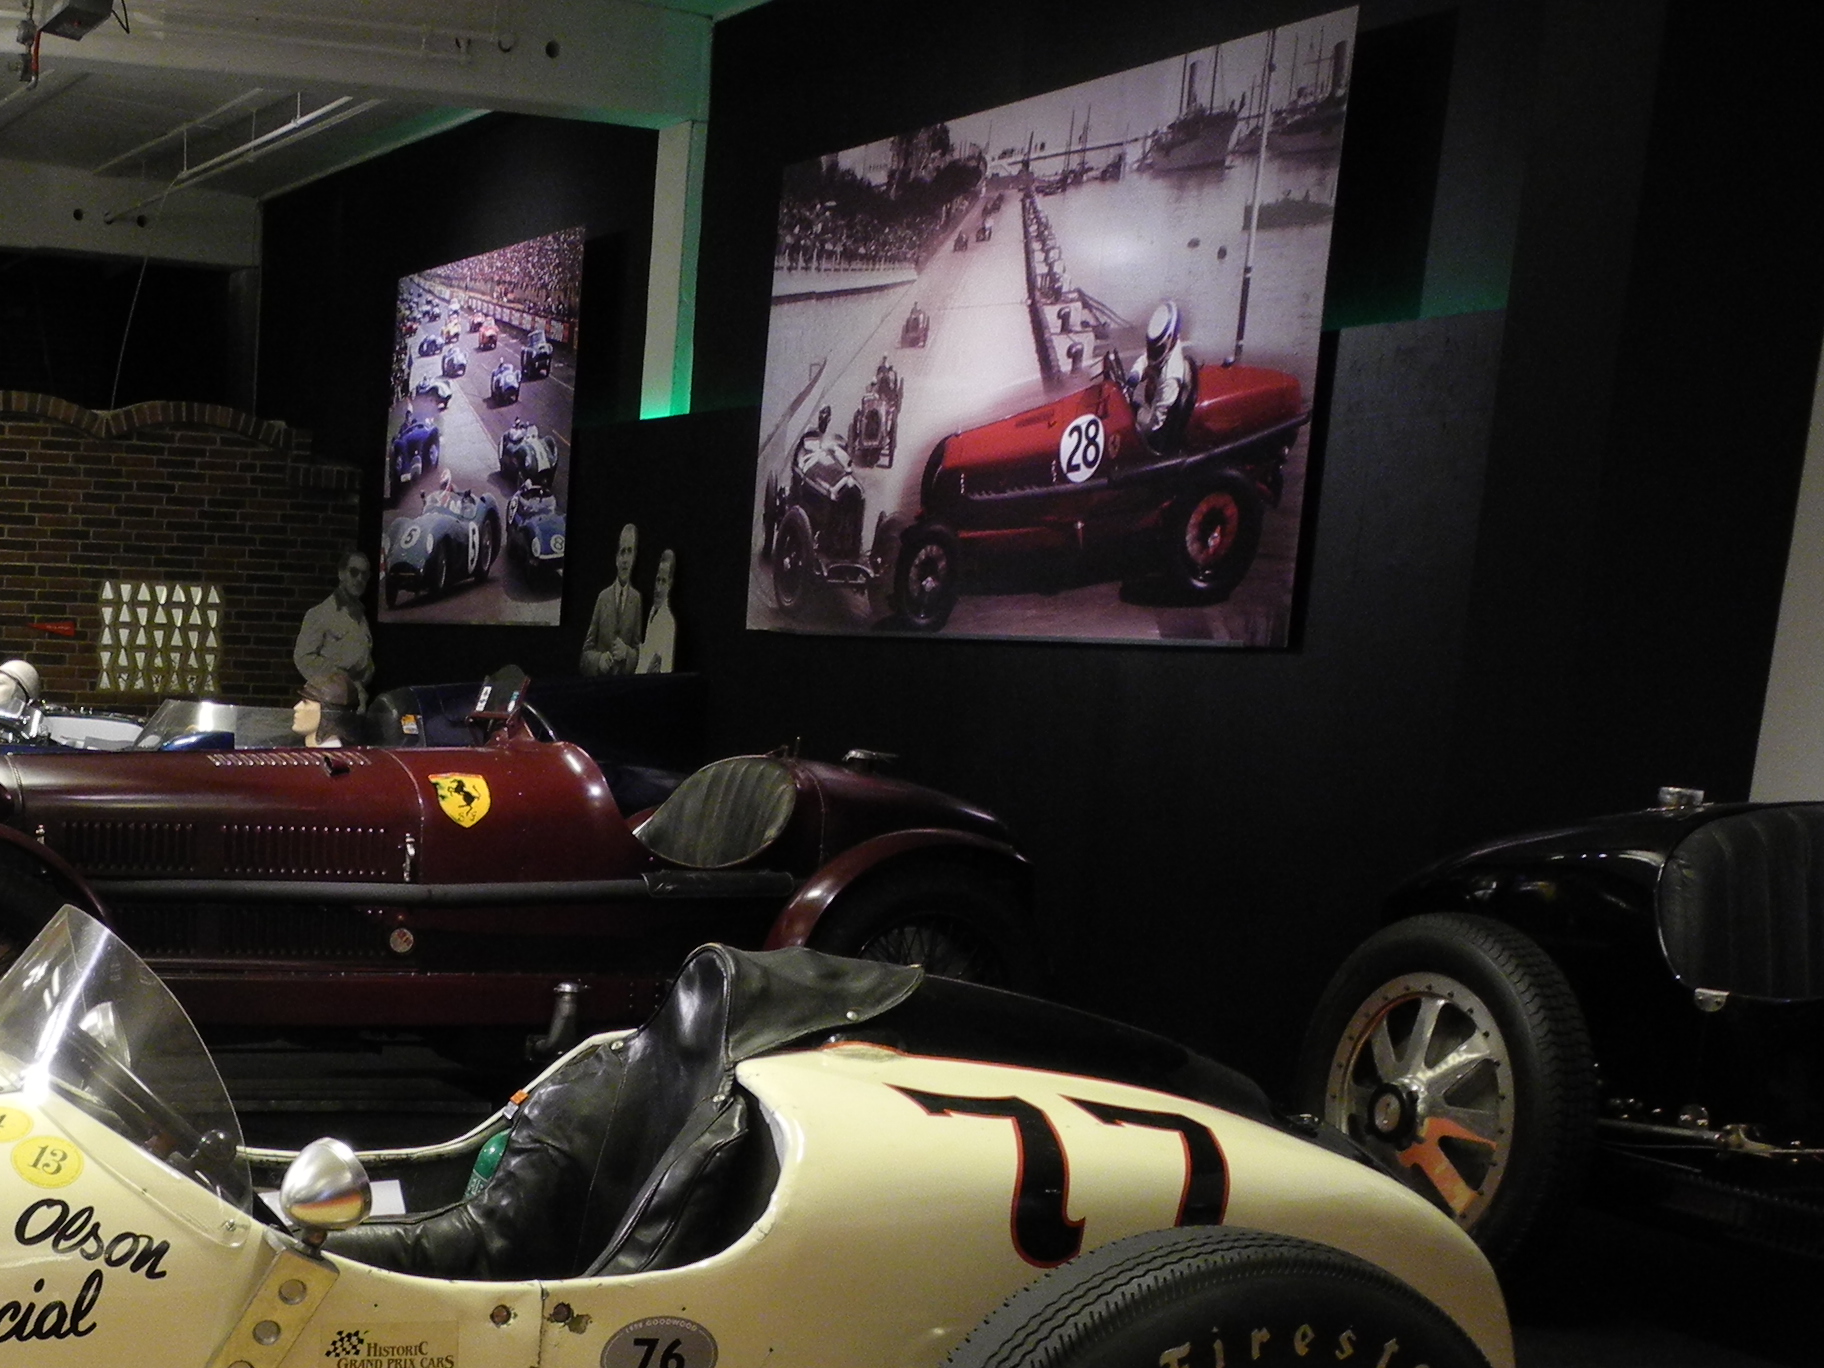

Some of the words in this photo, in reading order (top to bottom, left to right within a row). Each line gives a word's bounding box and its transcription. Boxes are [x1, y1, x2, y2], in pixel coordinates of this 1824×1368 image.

[1067, 418, 1100, 474] 28
[404, 528, 418, 544] 5
[28, 1144, 68, 1176] 13
[883, 1082, 1230, 1269] 77
[14, 1198, 171, 1280] Olson
[646, 1318, 698, 1332] GOODWOOD
[366, 1341, 429, 1357] HISTORIC
